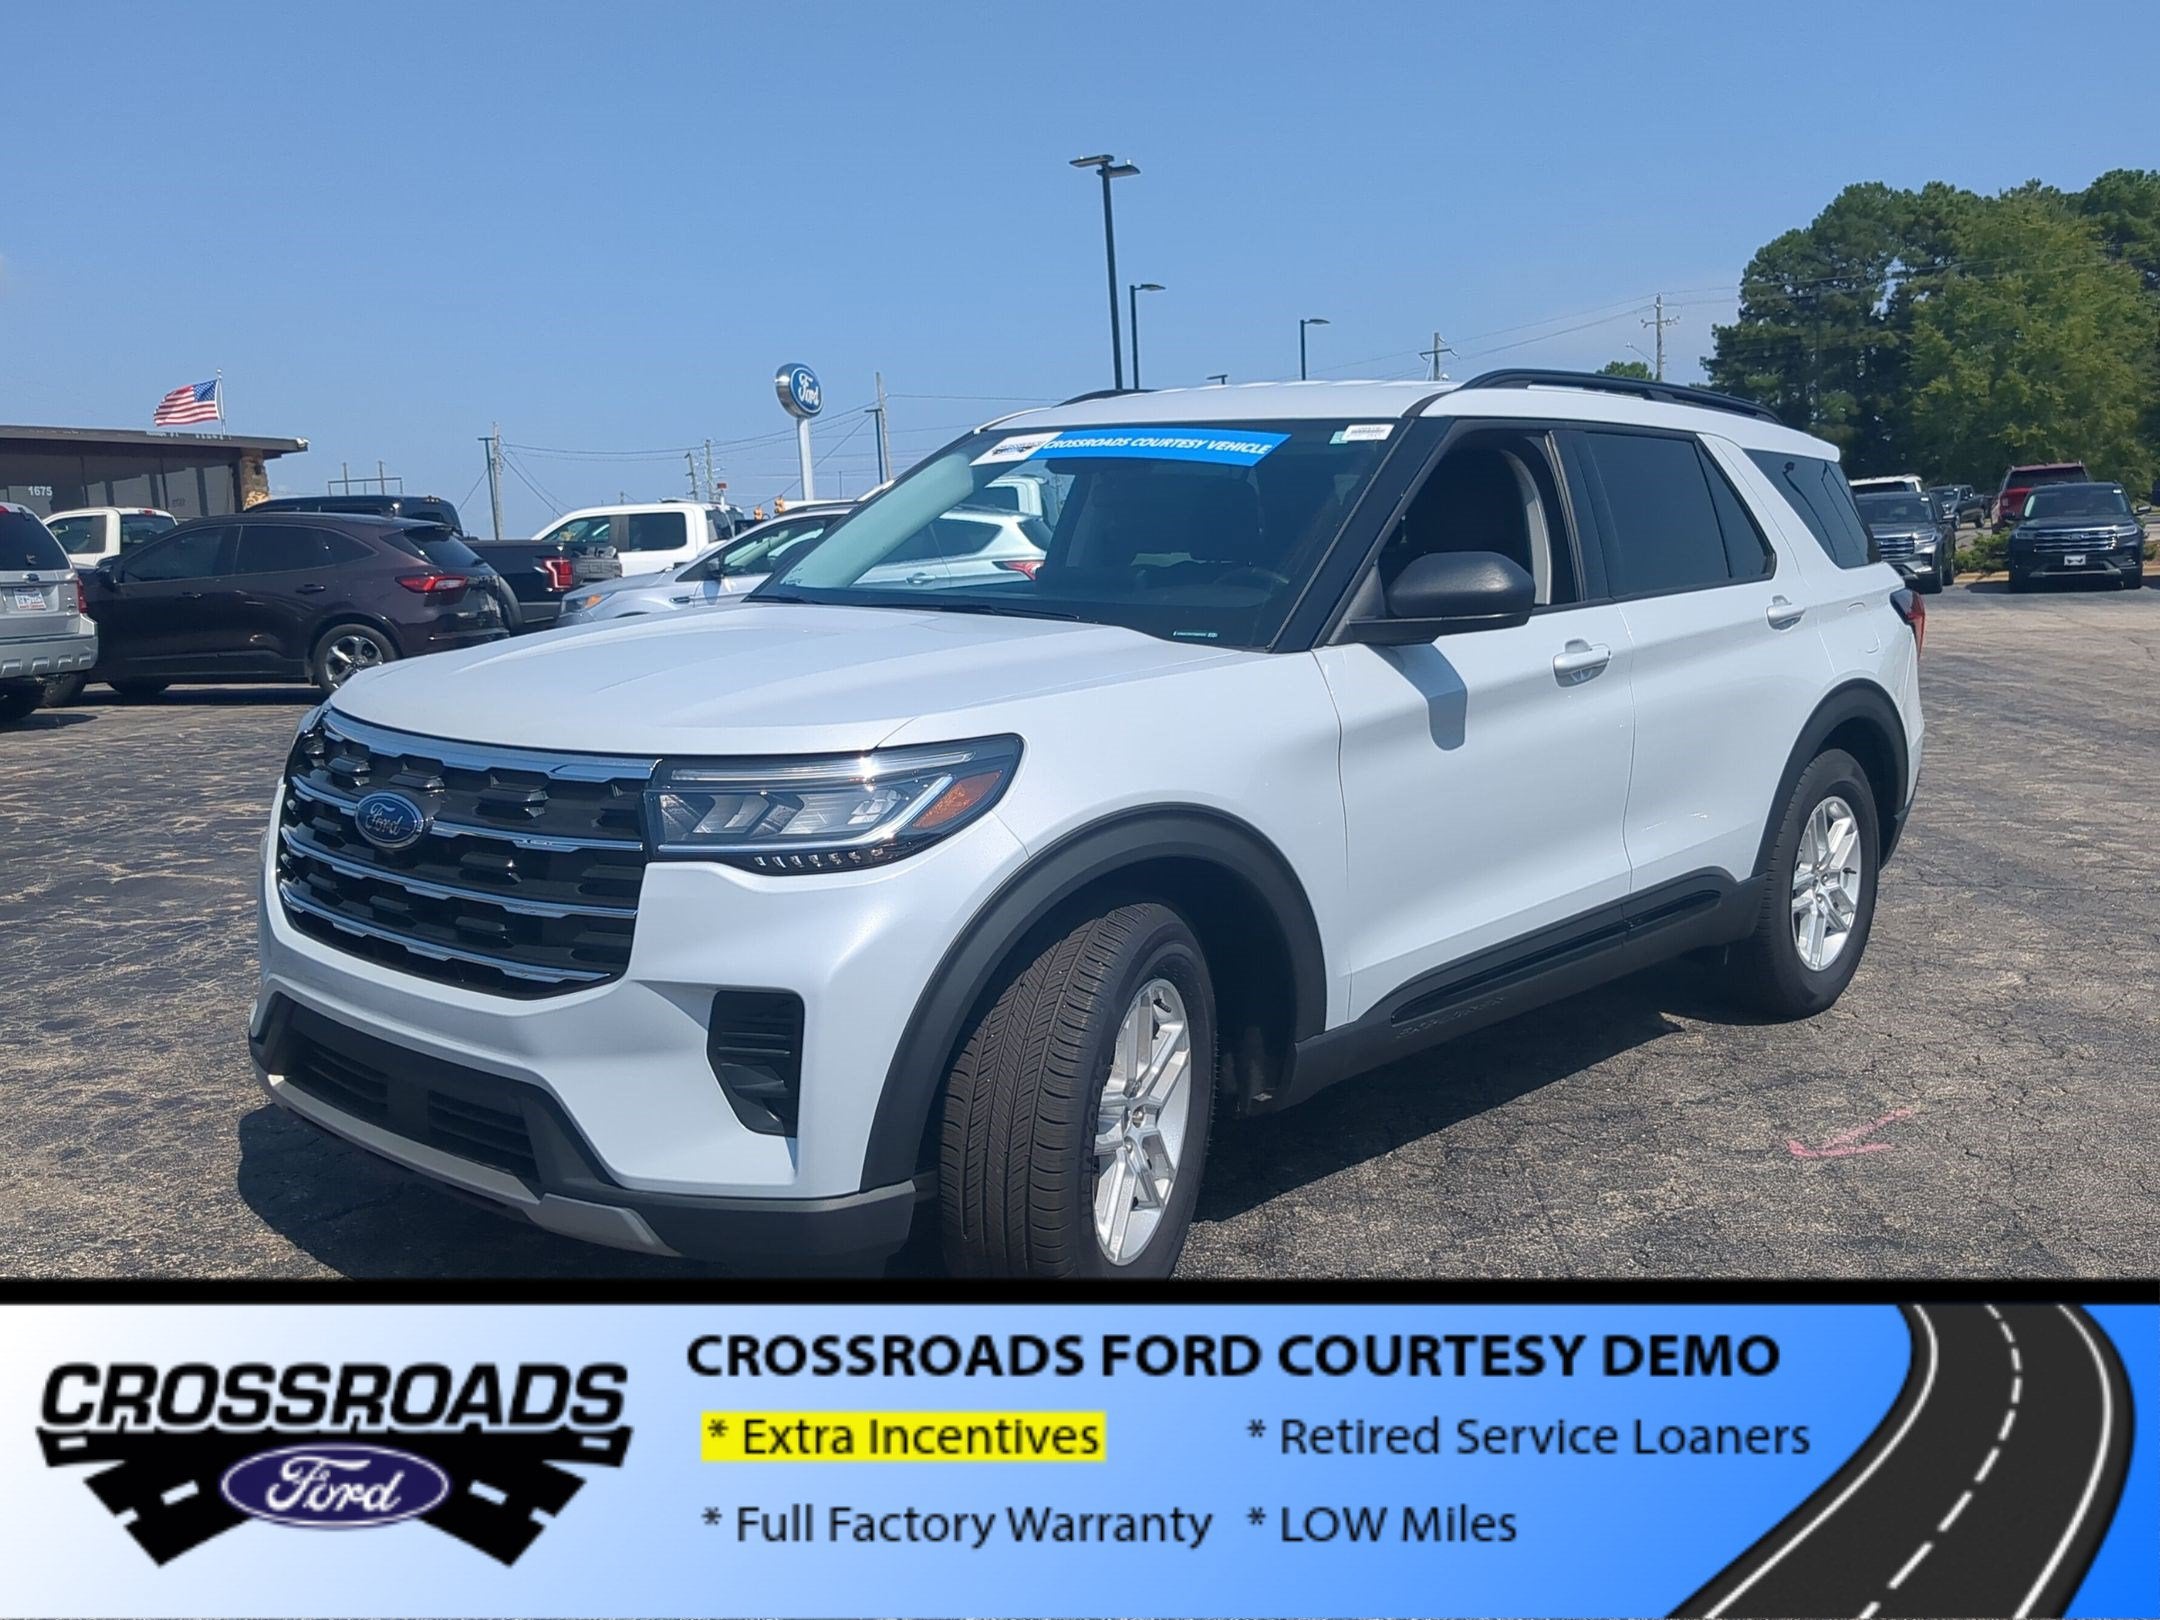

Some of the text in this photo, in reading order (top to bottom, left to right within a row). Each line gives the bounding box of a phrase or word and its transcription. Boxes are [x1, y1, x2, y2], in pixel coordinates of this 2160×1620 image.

[798, 373, 819, 406] Ford
[1043, 438, 1130, 449] CROSSROADS
[1131, 438, 1206, 449] COURTESY
[1206, 440, 1273, 454] VEHICLE
[28, 486, 53, 496] 1675
[365, 802, 404, 836] Ford
